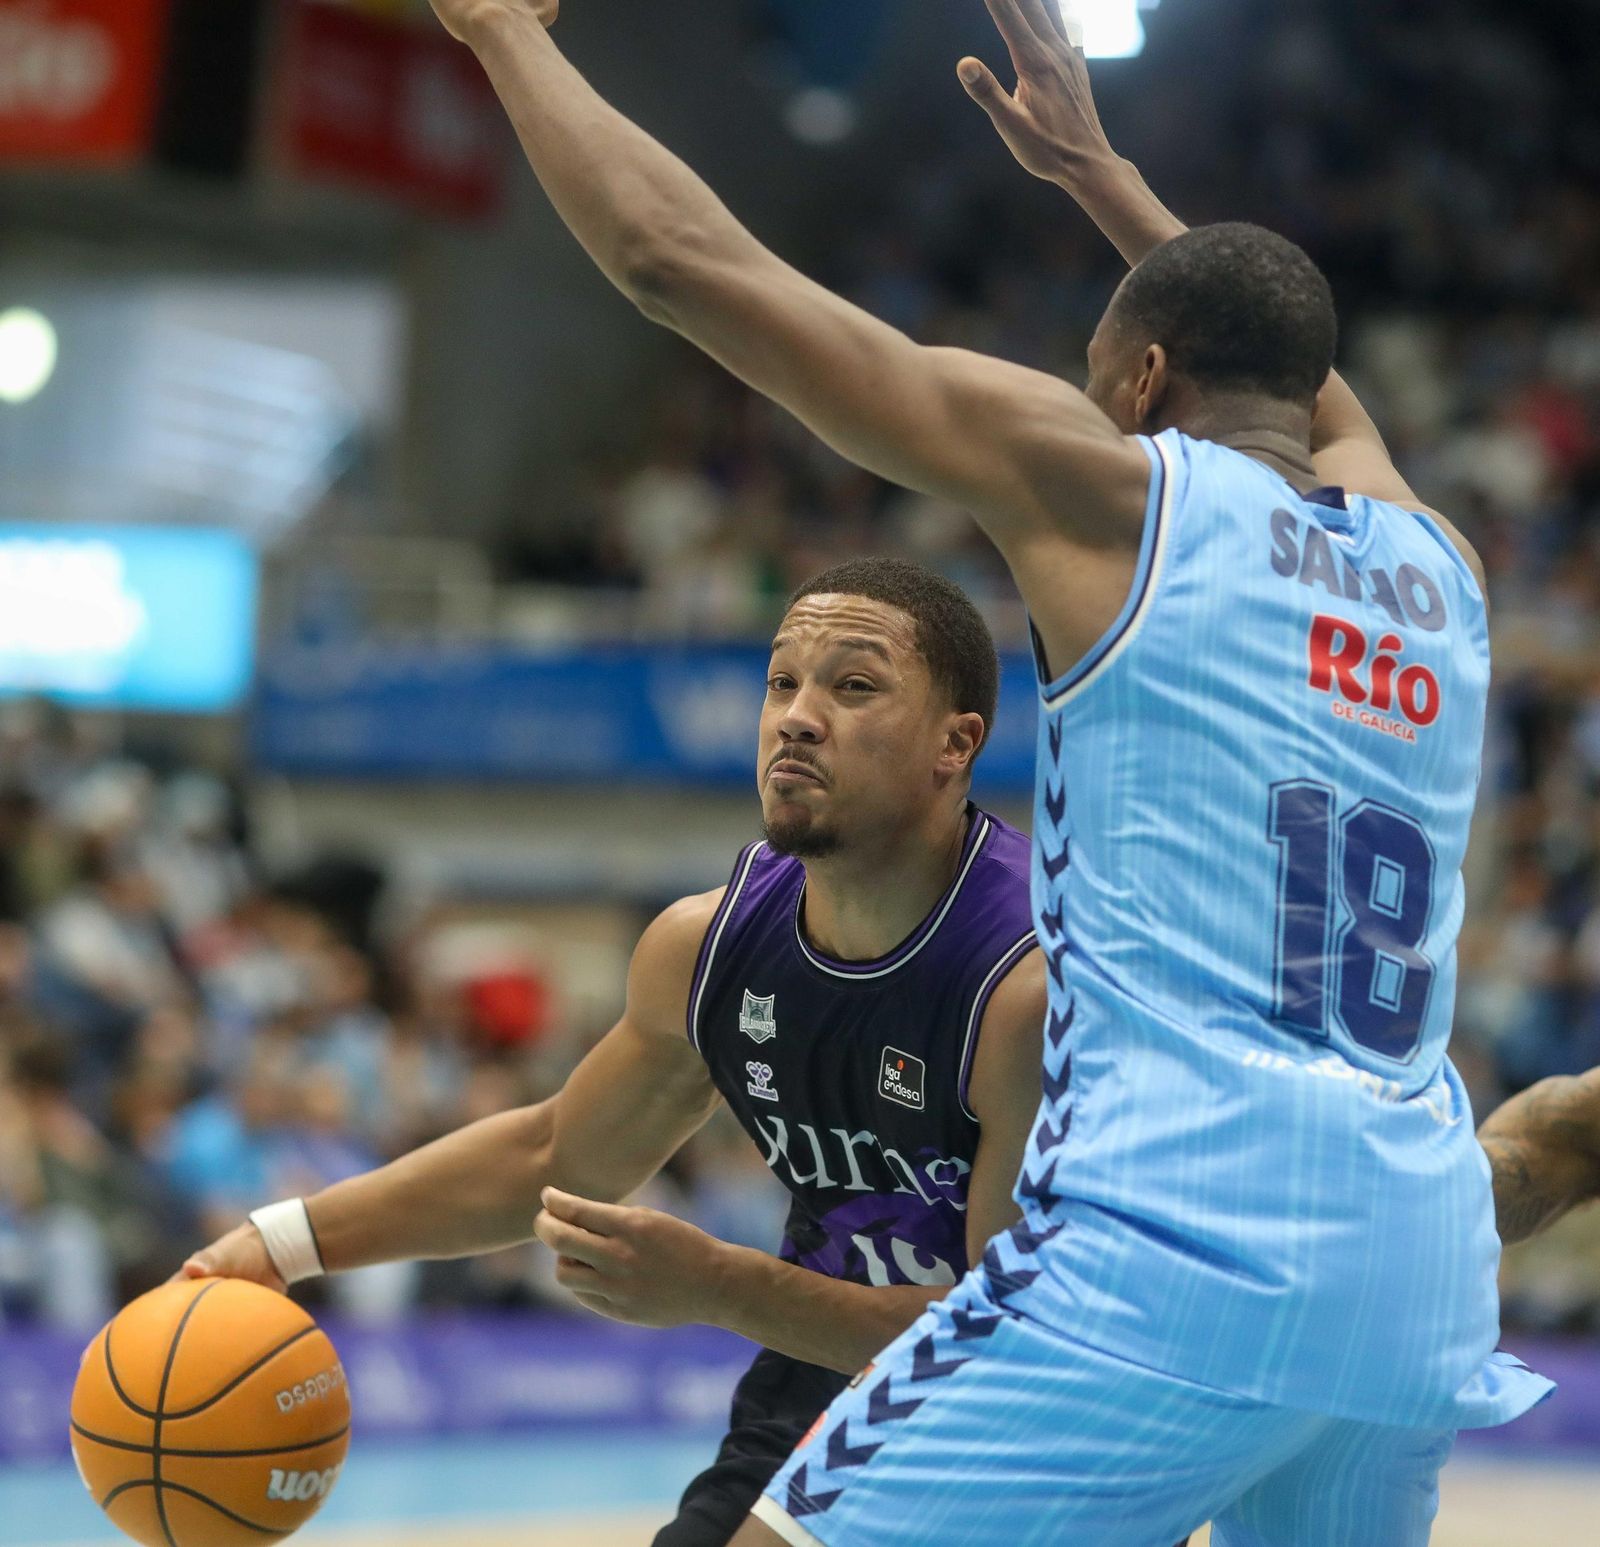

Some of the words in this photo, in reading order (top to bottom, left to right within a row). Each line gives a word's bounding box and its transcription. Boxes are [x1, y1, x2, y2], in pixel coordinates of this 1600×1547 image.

[1309, 614, 1441, 726] Río
[1332, 701, 1355, 721] DE
[1359, 711, 1417, 742] GALICIA
[1266, 777, 1438, 1066] 18
[883, 1079, 921, 1102] endesa
[885, 1063, 901, 1081] liga
